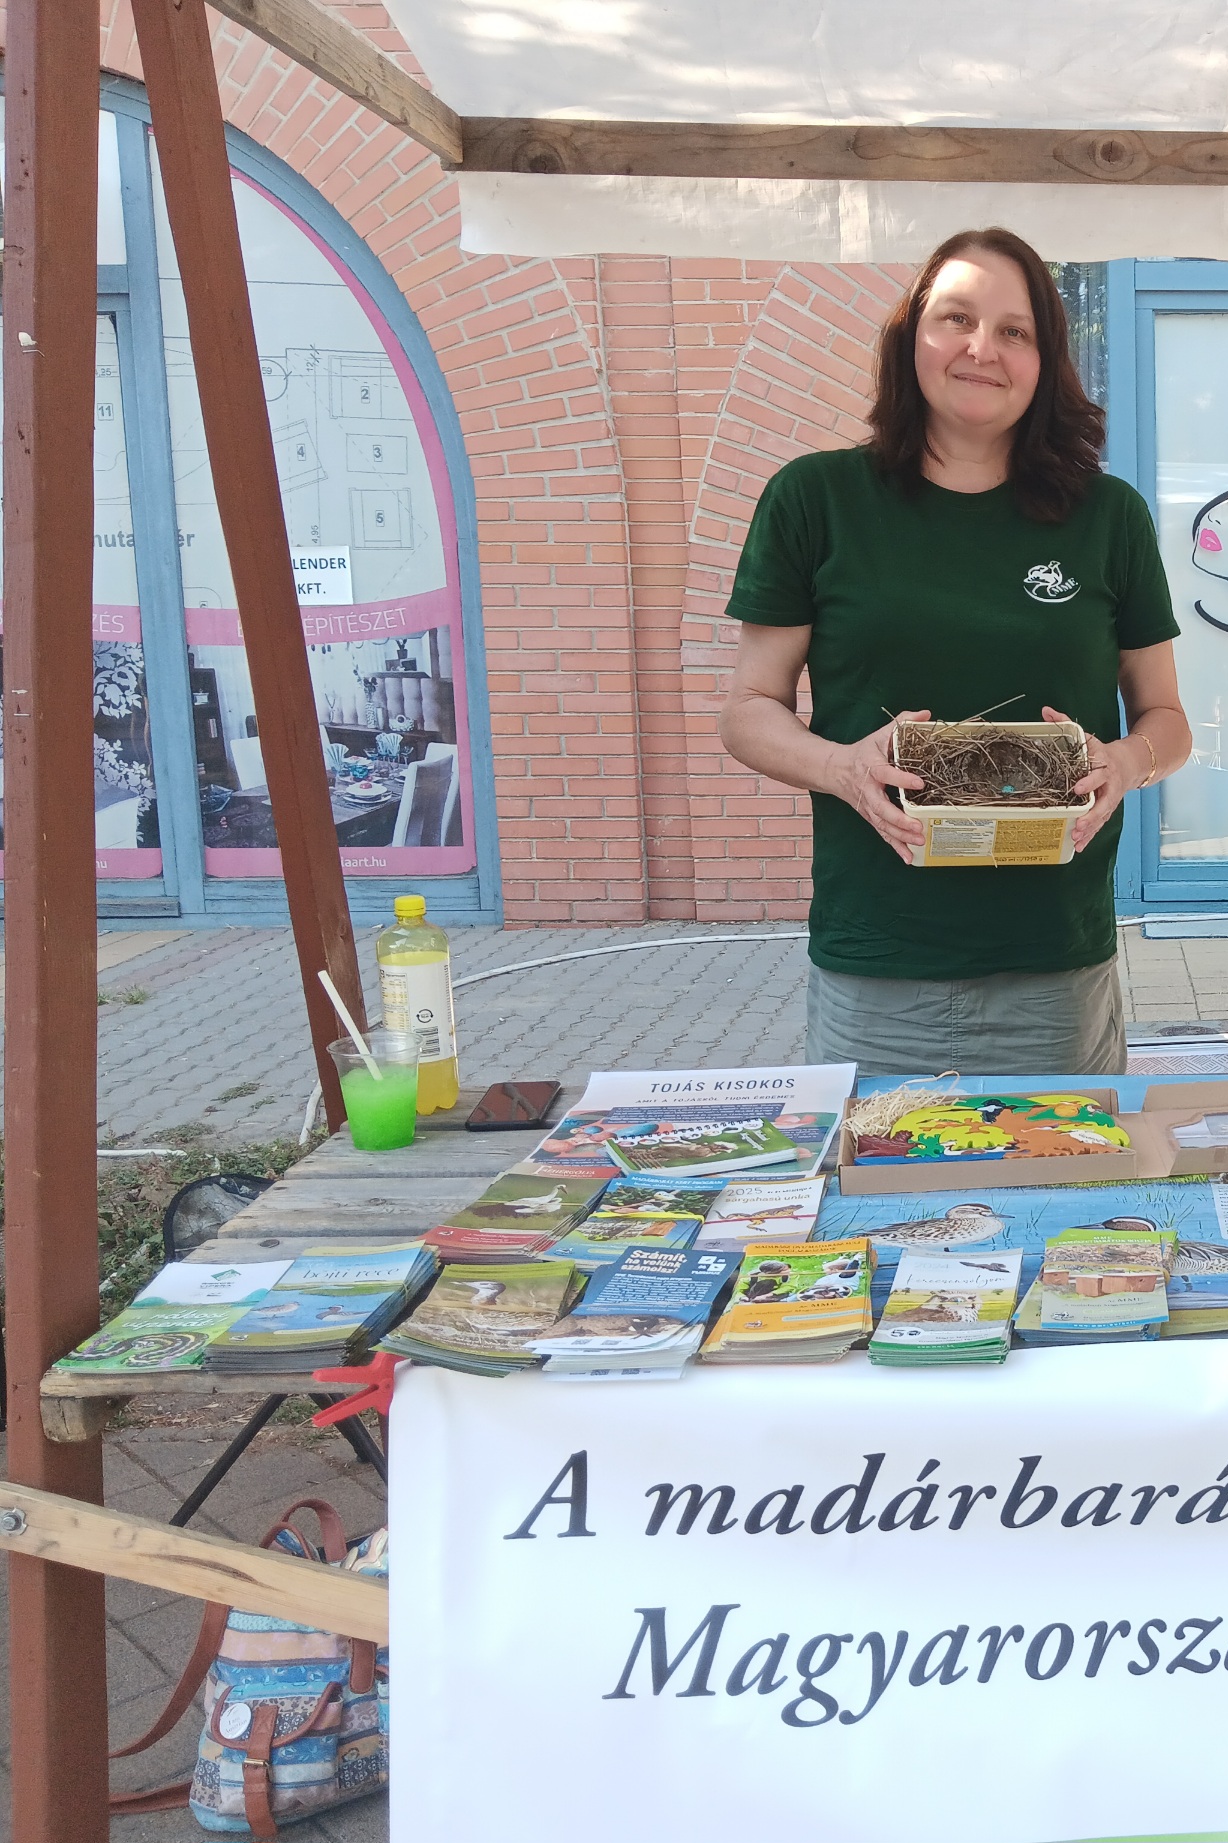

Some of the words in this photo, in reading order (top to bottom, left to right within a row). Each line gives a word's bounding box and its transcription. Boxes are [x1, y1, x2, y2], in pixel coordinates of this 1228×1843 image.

[95, 368, 111, 377] ,25
[361, 388, 369, 400] 2
[98, 405, 111, 416] 11
[297, 446, 305, 457] 4
[373, 446, 382, 458] 3
[376, 512, 384, 523] 5
[292, 557, 347, 570] LENDER
[297, 582, 326, 595] KFT.
[650, 1080, 706, 1093] TOJÁS
[714, 1078, 795, 1090] KISOKOS
[726, 1187, 762, 1197] 2025
[630, 1250, 687, 1263] Számít,
[621, 1264, 678, 1273] számolsz!
[643, 1258, 681, 1268] velünk
[504, 1448, 597, 1540] A
